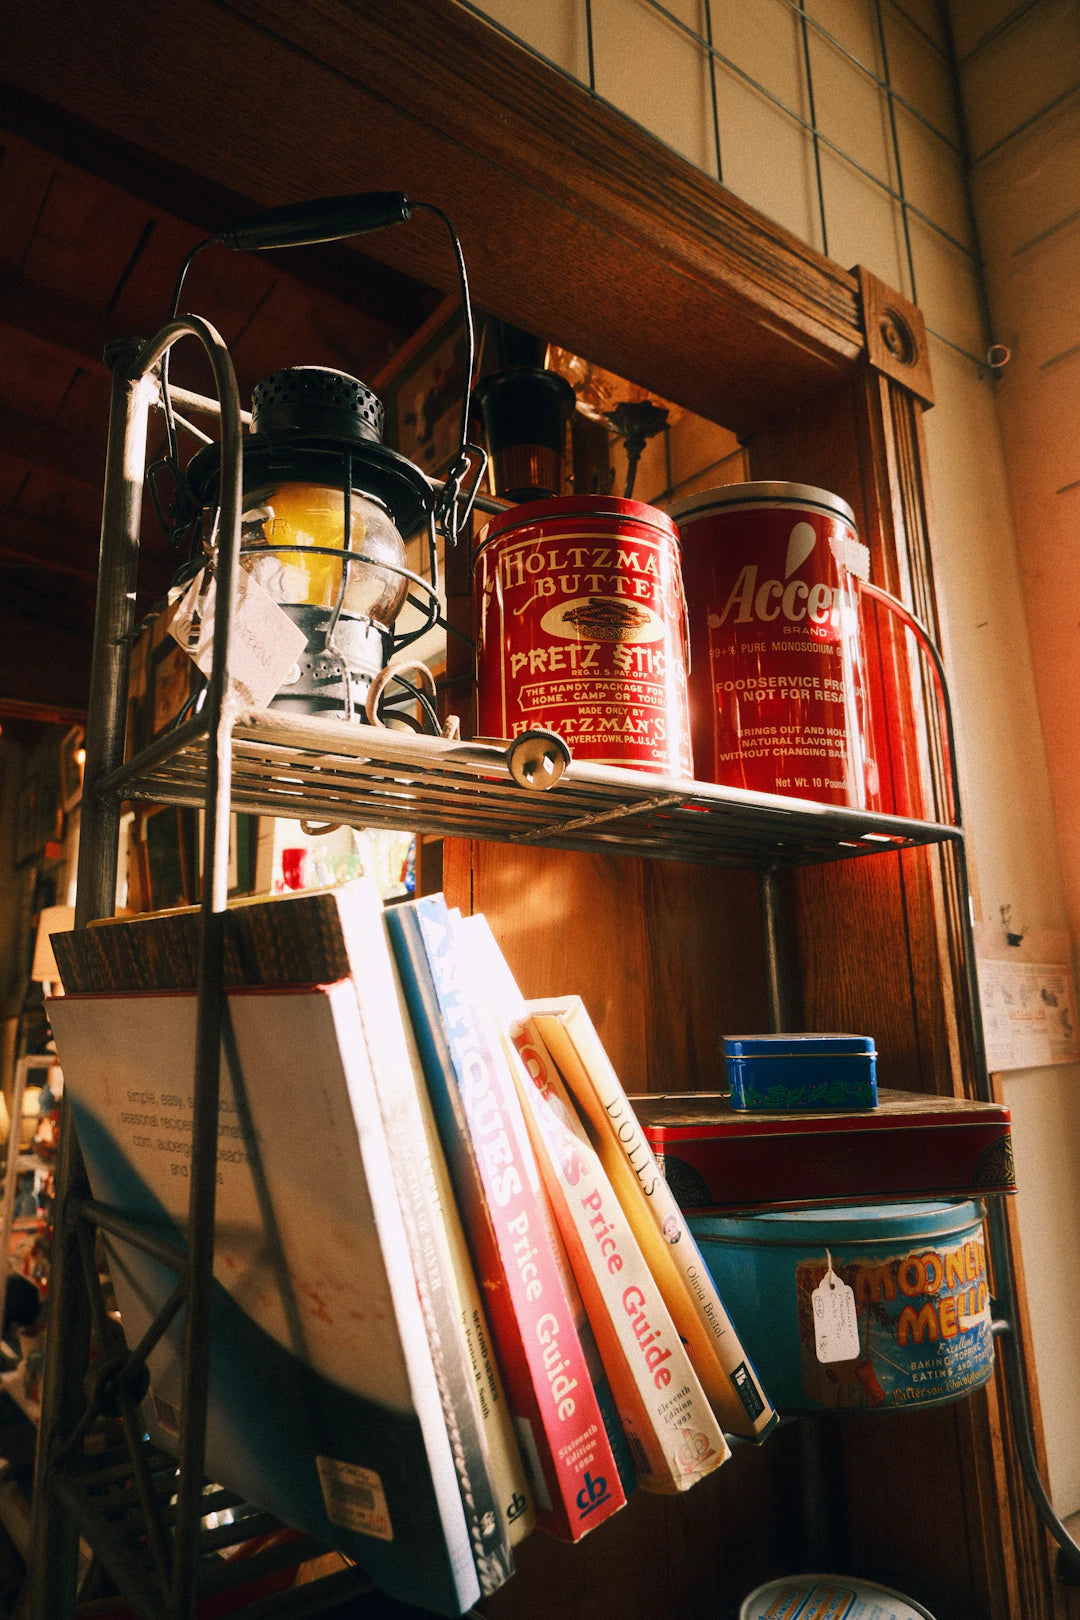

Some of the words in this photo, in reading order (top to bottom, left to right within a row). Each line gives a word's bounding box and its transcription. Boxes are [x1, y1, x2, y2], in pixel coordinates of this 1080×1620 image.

[783, 626, 828, 637] BRAND
[741, 642, 767, 654] PURE
[771, 641, 834, 655] MONOSODIUM
[510, 643, 602, 679] PRETZ
[526, 687, 546, 697] THE
[550, 683, 591, 693] HANDY
[595, 682, 643, 693] PACKAGE
[646, 686, 664, 697] FOR
[715, 676, 820, 693] FOODSERVICE
[743, 689, 775, 702] NOT
[781, 688, 810, 699] FOR
[573, 692, 607, 700] CAMP
[615, 692, 631, 701] OR
[578, 707, 605, 715] MADE
[605, 707, 629, 715] ONLY
[737, 726, 777, 738] BRINGS
[780, 726, 801, 735] OUT
[803, 726, 825, 735] AND
[742, 737, 793, 748] NATURAL
[795, 737, 833, 746] FLAVOR
[834, 739, 845, 748] OF
[719, 748, 770, 762] WITHOUT
[772, 747, 827, 757] CHANGING
[775, 777, 792, 788] Net
[794, 777, 810, 788] Wt.
[812, 777, 822, 787] 10
[604, 1096, 661, 1198] DOLLS
[580, 1187, 623, 1275] Price
[621, 1284, 672, 1390] Guide
[686, 1264, 706, 1301] Olivia
[701, 1301, 725, 1339] Bristol
[507, 1210, 544, 1302] Price
[535, 1312, 581, 1422] Guide
[472, 1309, 488, 1359] SECOND
[484, 1360, 499, 1402] SERIES
[912, 1366, 953, 1383] EATING
[957, 1361, 971, 1372] AND
[478, 1386, 490, 1420] Smith
[657, 1385, 691, 1416] Eleventh
[663, 1399, 693, 1424] Edition
[673, 1412, 692, 1430] 1993
[558, 1424, 598, 1459] Sixteenth
[565, 1439, 597, 1467] Edition
[576, 1472, 607, 1510] cb
[506, 1492, 527, 1520] cb
